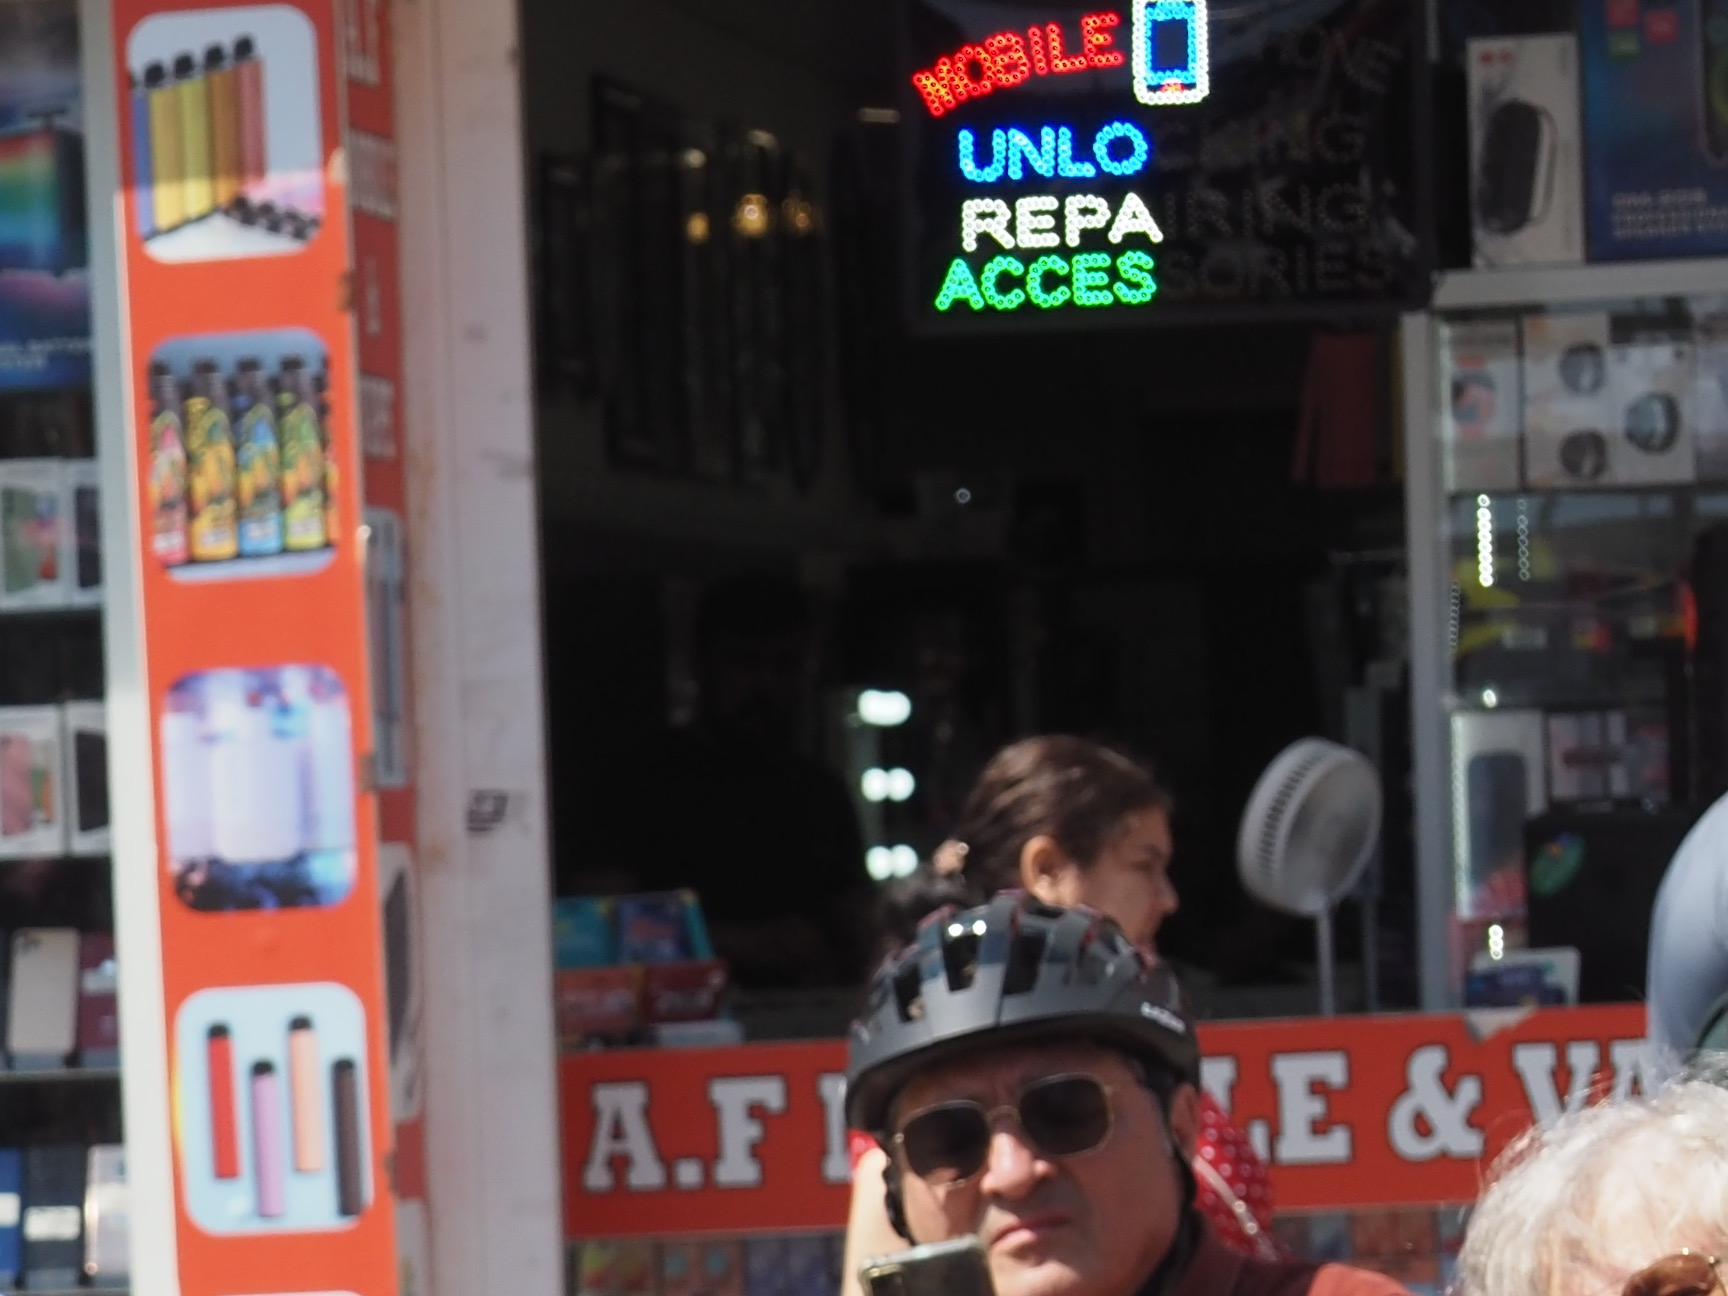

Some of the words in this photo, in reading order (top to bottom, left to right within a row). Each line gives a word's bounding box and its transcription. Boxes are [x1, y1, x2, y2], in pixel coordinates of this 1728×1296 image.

[910, 8, 1126, 117] MOBILE
[583, 1074, 788, 1192] A.F
[1388, 1044, 1486, 1162] &
